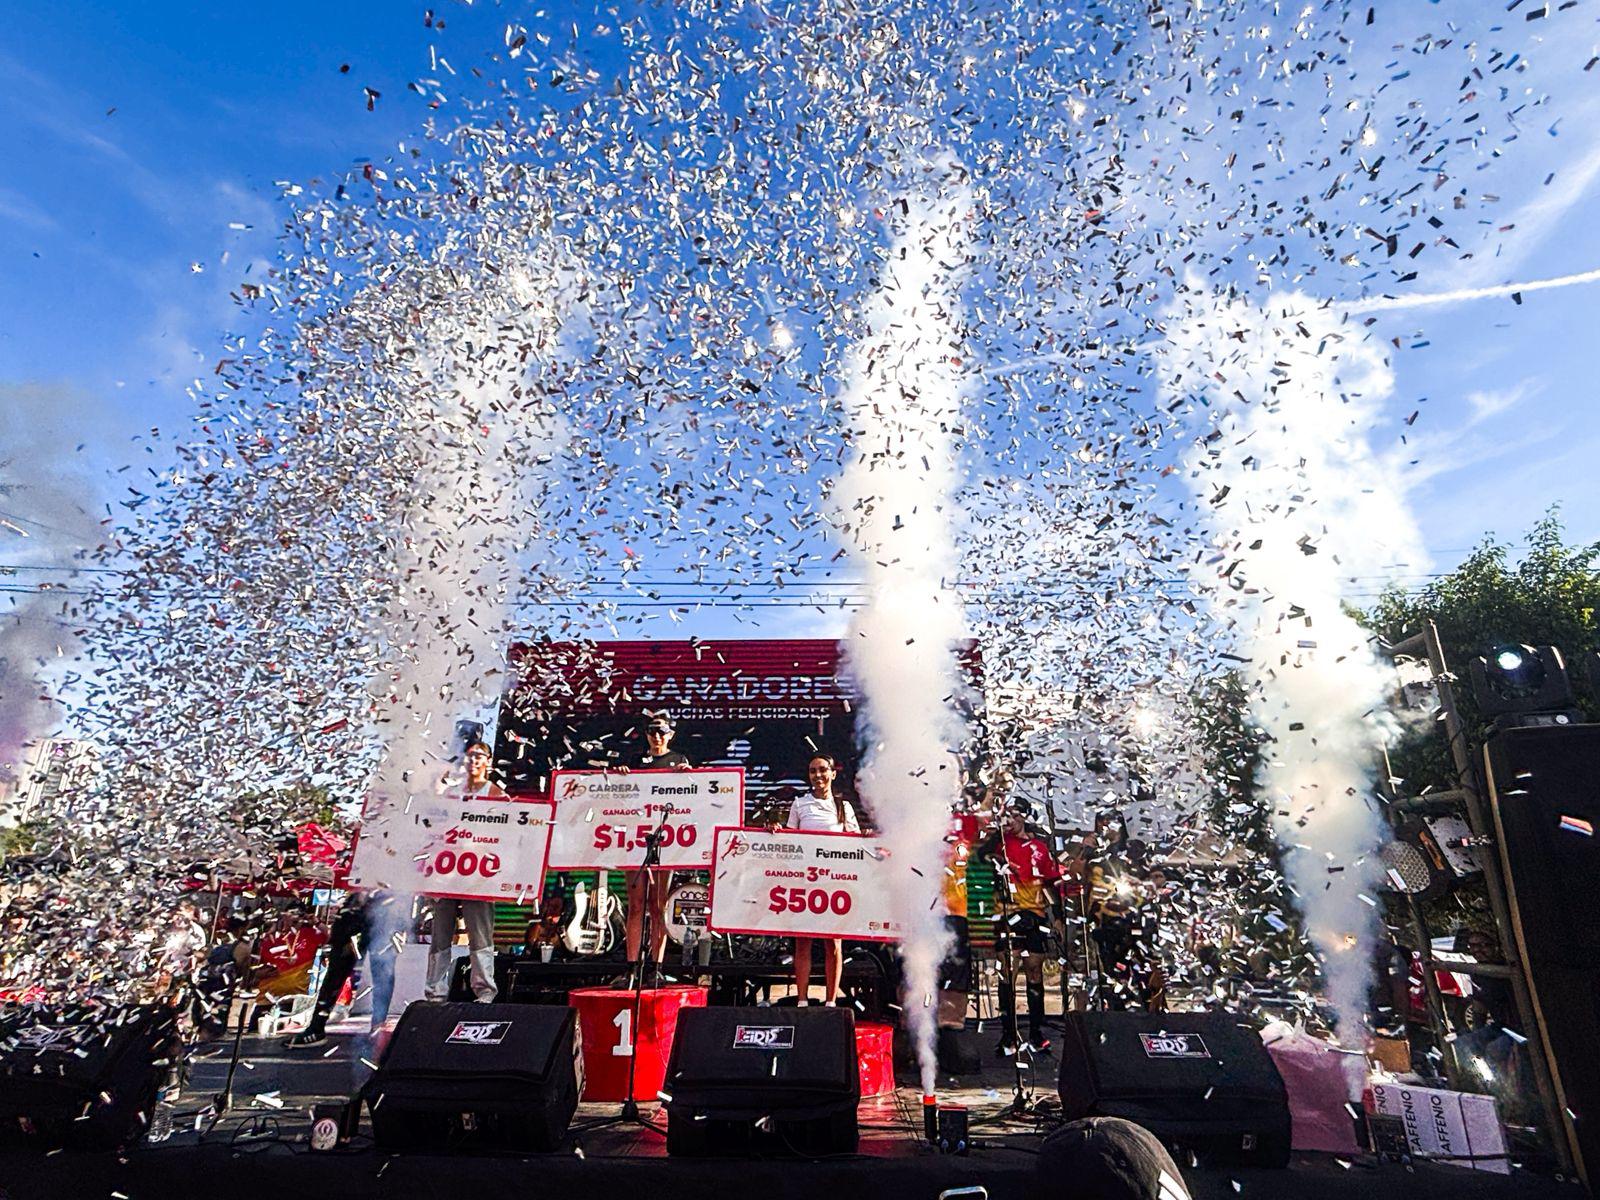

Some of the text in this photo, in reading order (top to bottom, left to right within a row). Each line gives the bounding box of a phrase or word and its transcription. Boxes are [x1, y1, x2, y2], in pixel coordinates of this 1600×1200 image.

[633, 676, 858, 700] GANADORES
[670, 707, 831, 719] UCHAS FELICIDADES
[588, 784, 641, 793] CARRERA
[651, 784, 699, 795] Femenil
[460, 811, 509, 824] Femenil
[602, 808, 642, 817] GANADO
[472, 836, 499, 844] LUGAR
[593, 823, 698, 852] $1,500
[751, 842, 804, 854] CARRERA
[815, 847, 865, 860] Femenil
[764, 869, 805, 878] GANADOR
[806, 866, 831, 882] 3er
[768, 885, 852, 915] $500
[612, 1009, 633, 1056] 1
[1430, 1095, 1452, 1154] AFFENIO
